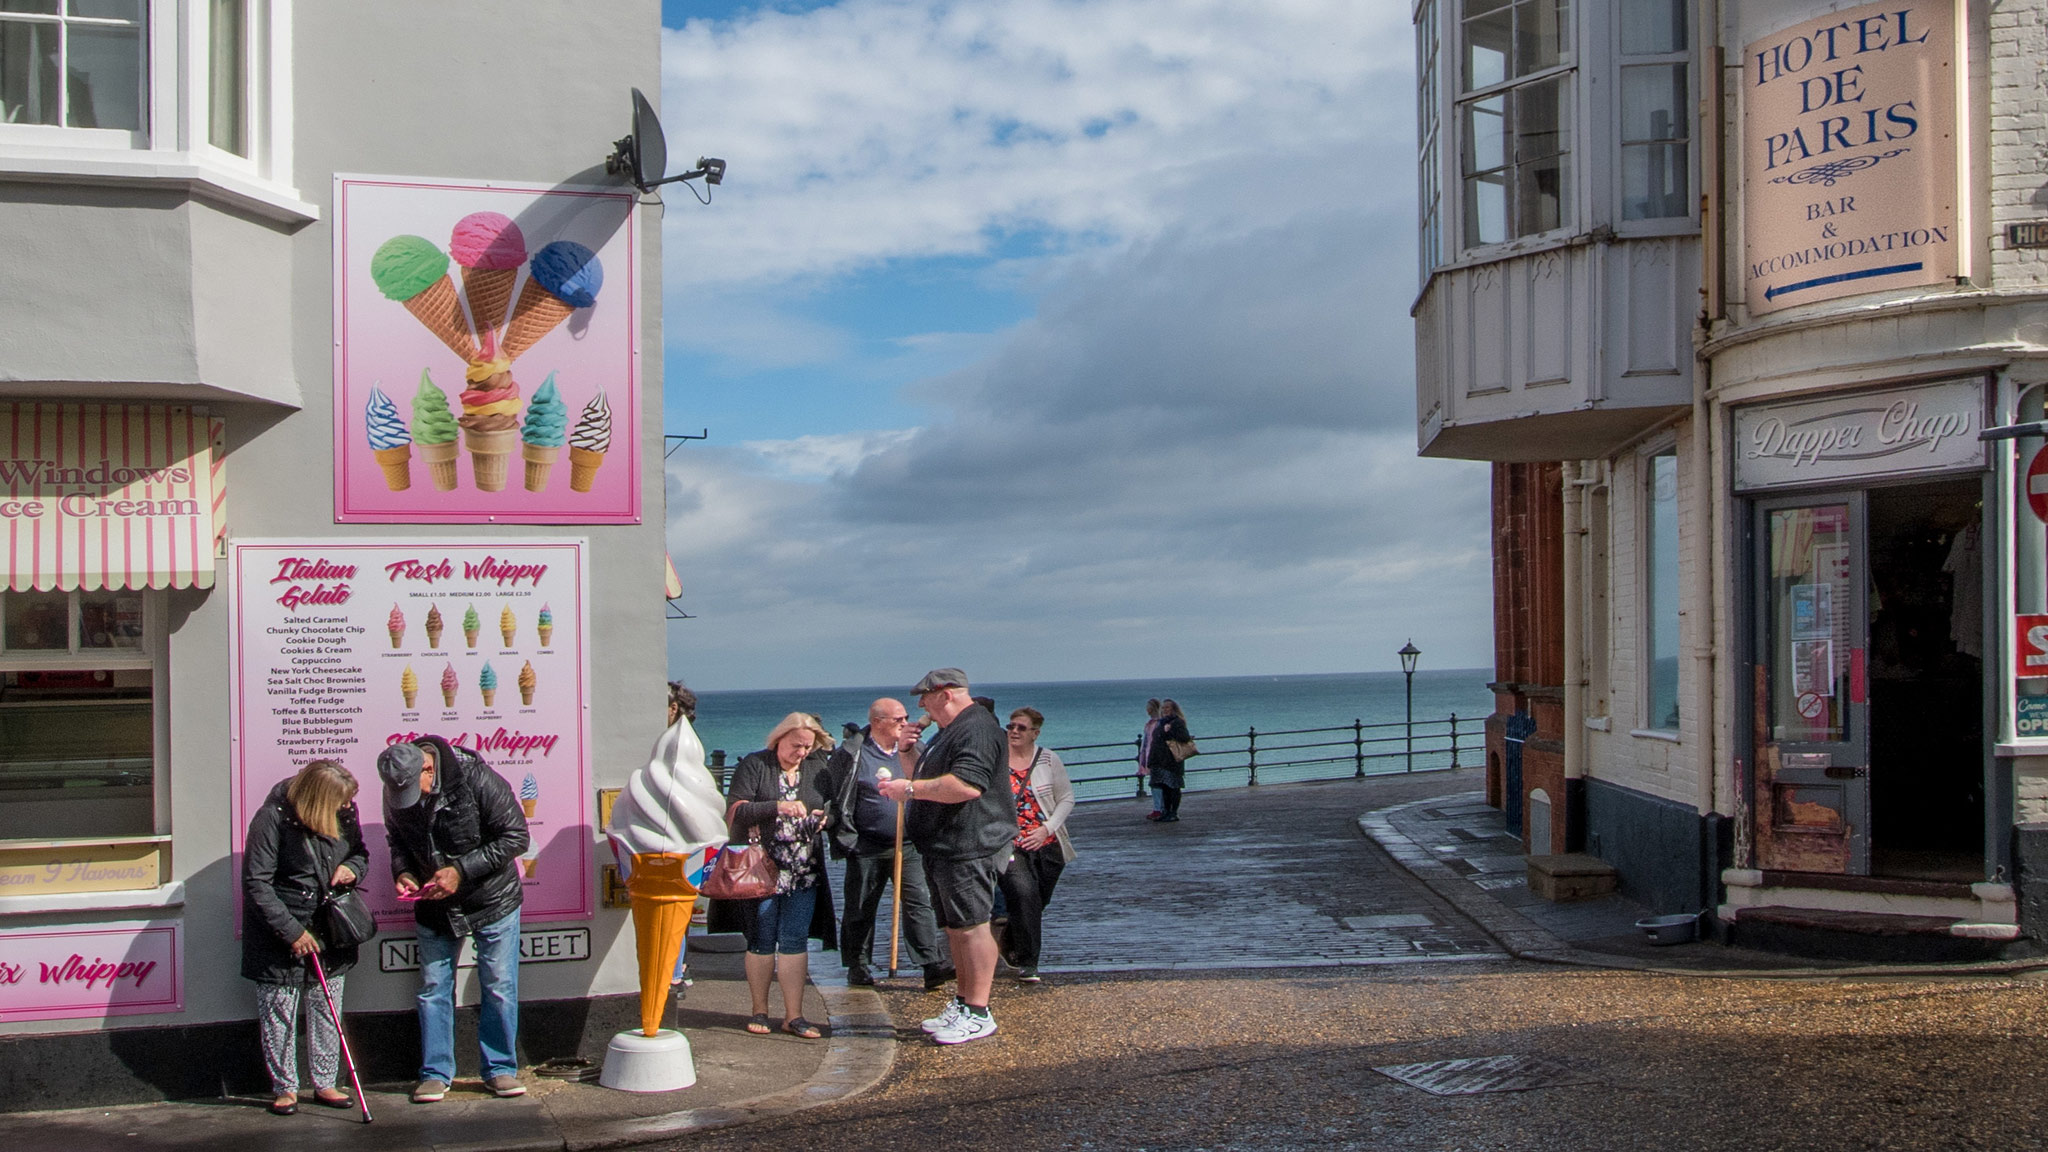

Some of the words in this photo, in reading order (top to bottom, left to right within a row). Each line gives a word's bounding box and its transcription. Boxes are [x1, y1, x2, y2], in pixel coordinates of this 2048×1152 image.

[1755, 8, 1930, 87] HOTEL
[1797, 64, 1866, 115] DE
[1764, 100, 1918, 171] PARIS
[1806, 196, 1857, 221] BAR
[1822, 221, 1839, 239] &
[1749, 226, 1949, 280] ACCOMMODATION
[1747, 416, 1864, 467] Dapper
[1877, 399, 1971, 452] Chaps
[0, 459, 190, 485] Windows
[61, 492, 201, 518] Cream
[269, 557, 359, 585] Italian
[384, 557, 455, 584] Fresh
[463, 555, 549, 587] Whippy
[276, 583, 352, 612] Gelato
[266, 627, 299, 635] Chunky
[345, 626, 365, 634] Chip
[284, 616, 311, 624] Salted
[317, 636, 346, 645] Dough
[291, 657, 342, 665] Cappuccino
[285, 677, 301, 685] Salt
[298, 688, 326, 696] Fudge
[308, 706, 362, 714] Butterscotch
[318, 697, 344, 705] Fudge
[303, 717, 353, 725] Bubblegum
[303, 727, 353, 736] Bubblegum
[277, 738, 325, 746] Strawberry
[326, 737, 358, 745] Fragola
[318, 747, 348, 755] Raisins
[475, 726, 559, 757] Whippy
[65, 858, 148, 882] Flavours
[39, 953, 157, 989] Whippy
